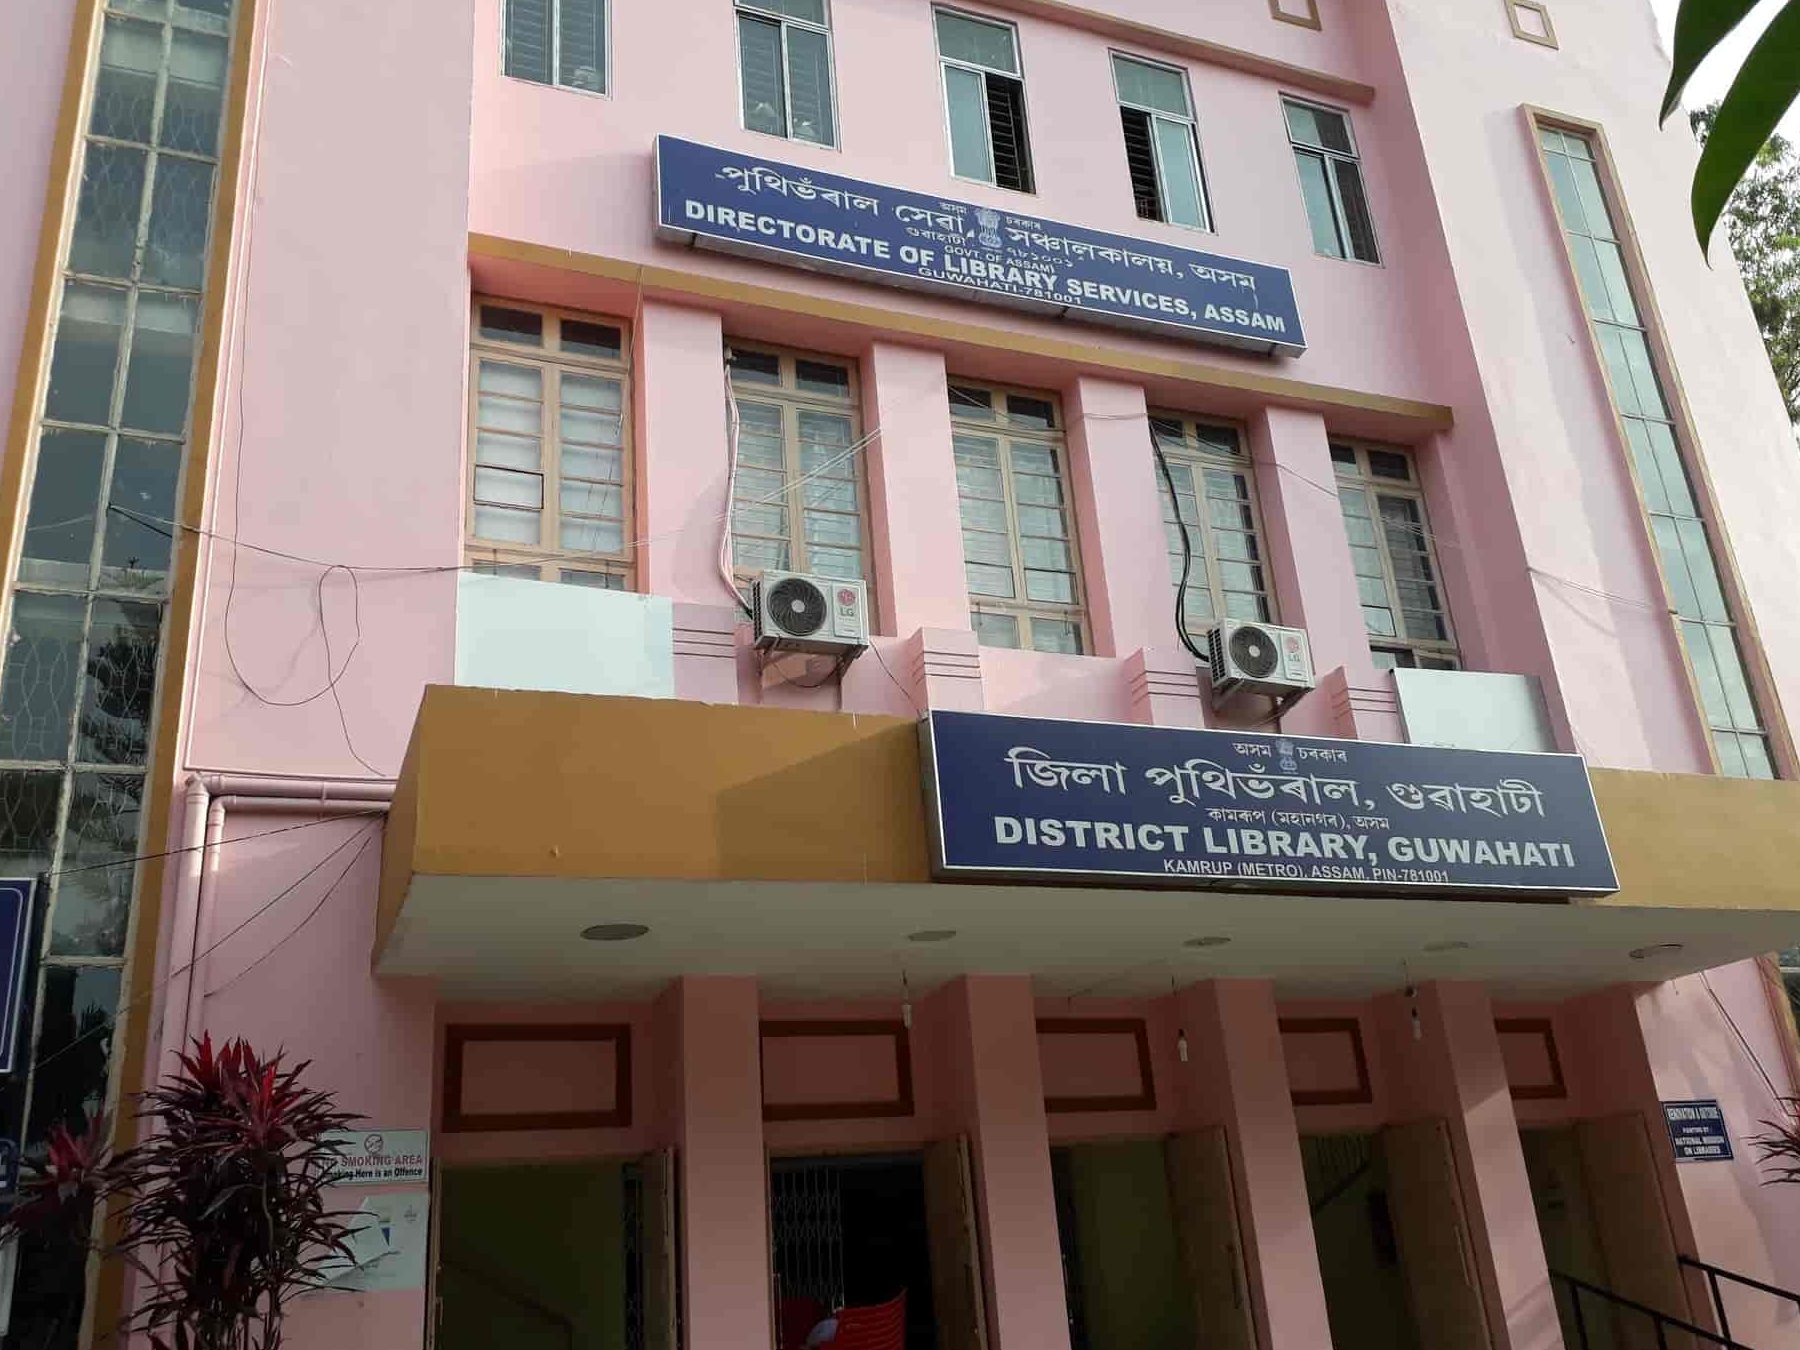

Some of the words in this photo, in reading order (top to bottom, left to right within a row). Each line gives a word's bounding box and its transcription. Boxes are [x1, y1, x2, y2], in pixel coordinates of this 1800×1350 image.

[685, 199, 891, 260] DIRECTORATE
[899, 245, 935, 267] OF
[943, 254, 1057, 291] LIBRARY
[1066, 278, 1196, 320] SERVICES,
[1204, 303, 1286, 333] ASSAM
[986, 253, 1003, 263] OF
[1188, 263, 1256, 290] অসম
[841, 607, 855, 617] LG
[1232, 742, 1272, 757] অসম
[1296, 747, 1348, 763] চৰকাৰ
[1004, 746, 1129, 795] জিলা
[1387, 778, 1546, 818] গুৱাহাটী
[1352, 815, 1390, 831] অসম
[994, 816, 1189, 853] DISTRICT
[1203, 827, 1377, 866] LIBRARY,
[1388, 836, 1576, 868] GUWAHATI
[1163, 859, 1233, 874] KAMRUP
[1372, 868, 1450, 884] PIN-781001
[341, 1155, 391, 1167] SMOKING
[394, 1154, 422, 1166] AREA
[383, 1169, 393, 1177] an
[394, 1166, 423, 1177] Offence
